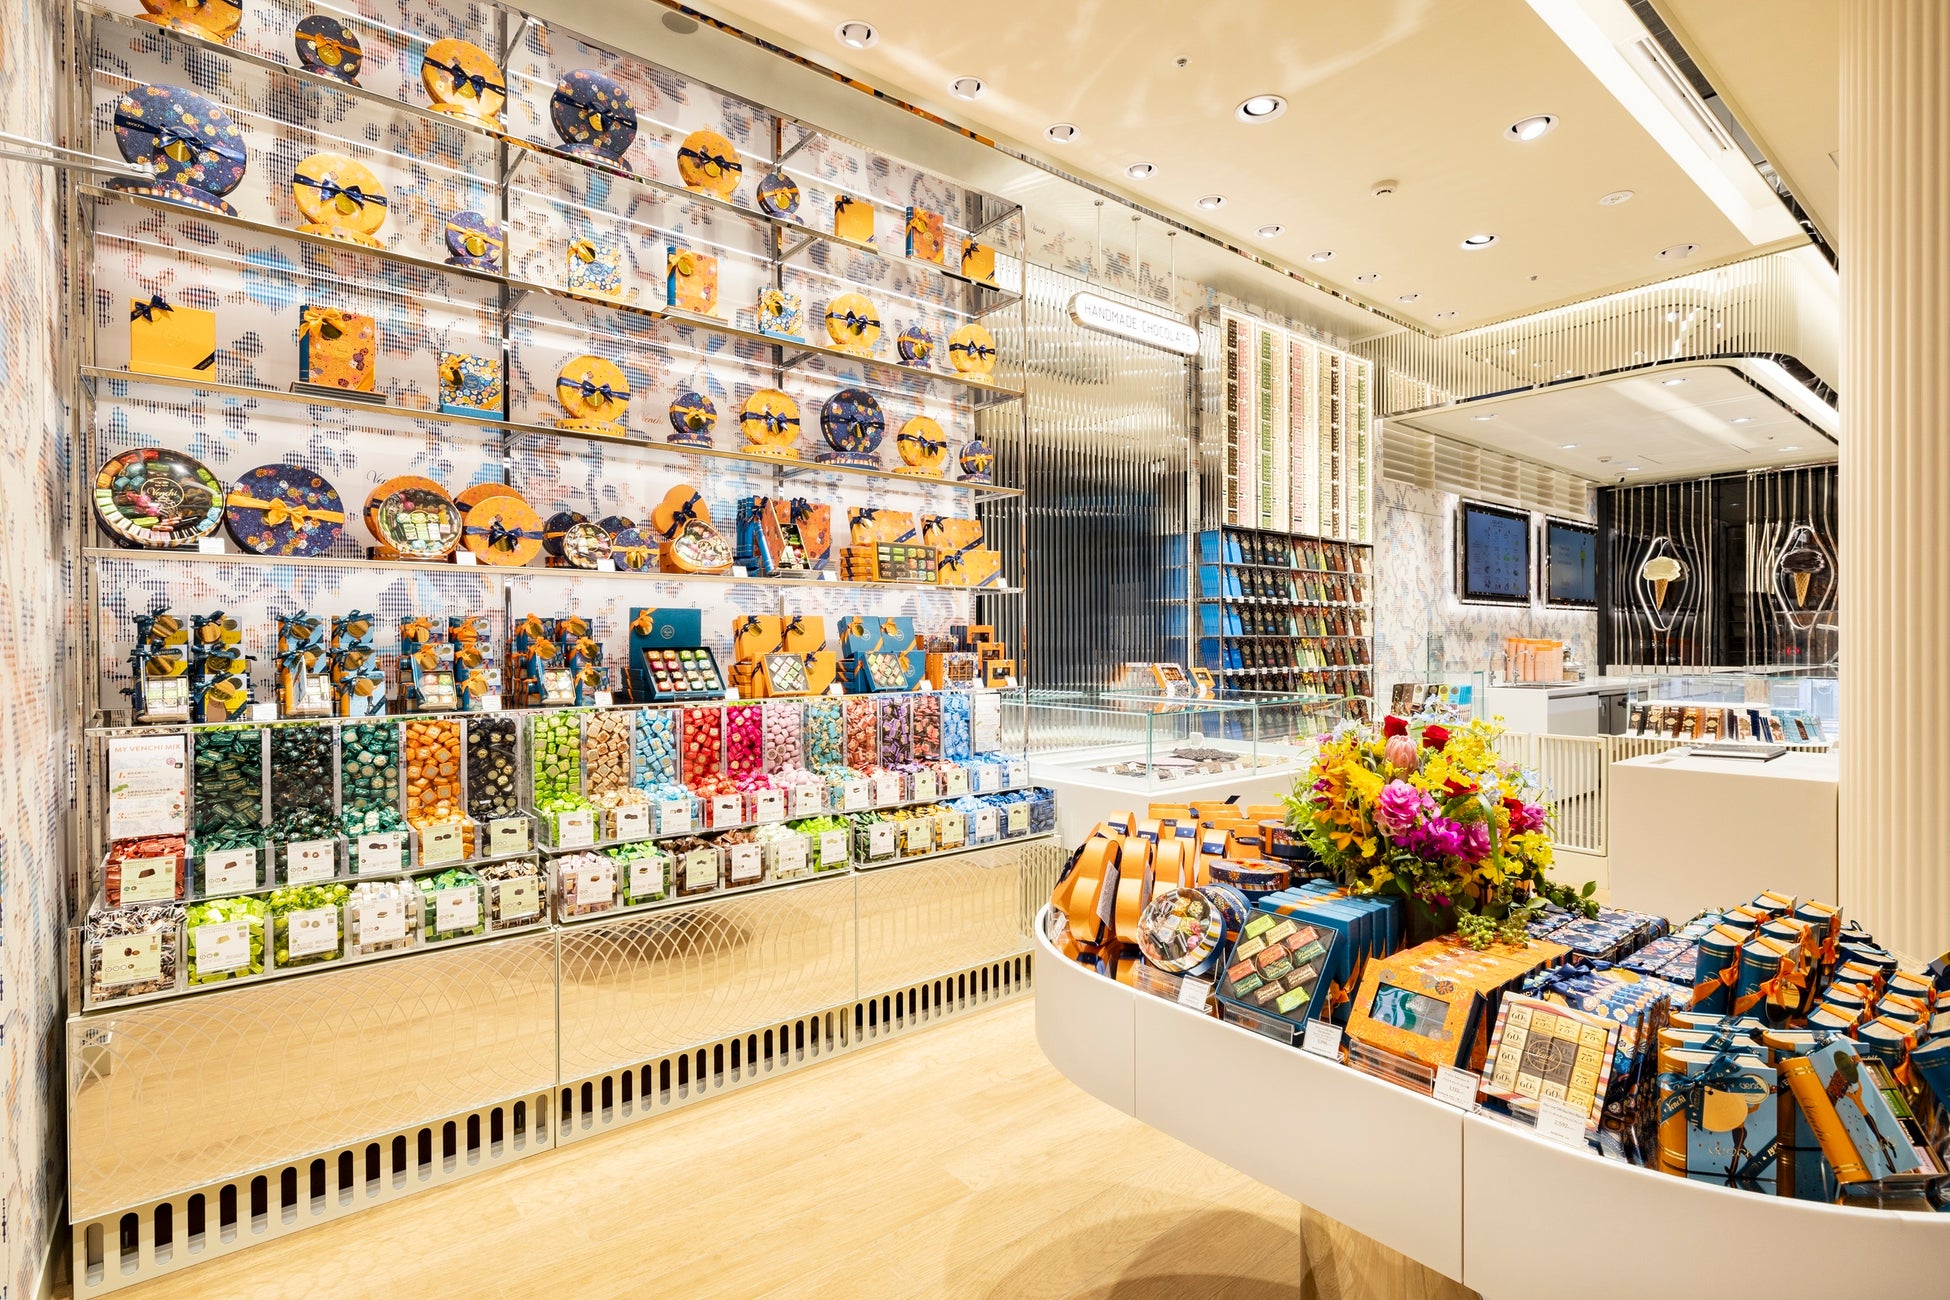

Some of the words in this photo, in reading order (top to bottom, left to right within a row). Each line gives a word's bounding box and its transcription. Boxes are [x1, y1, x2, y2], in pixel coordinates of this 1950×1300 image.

[1083, 302, 1137, 330] HANDMADE
[1142, 320, 1192, 347] CHOCOLATE
[146, 486, 178, 498] Venchi
[130, 744, 163, 752] VENCHI
[164, 743, 181, 751] MIX
